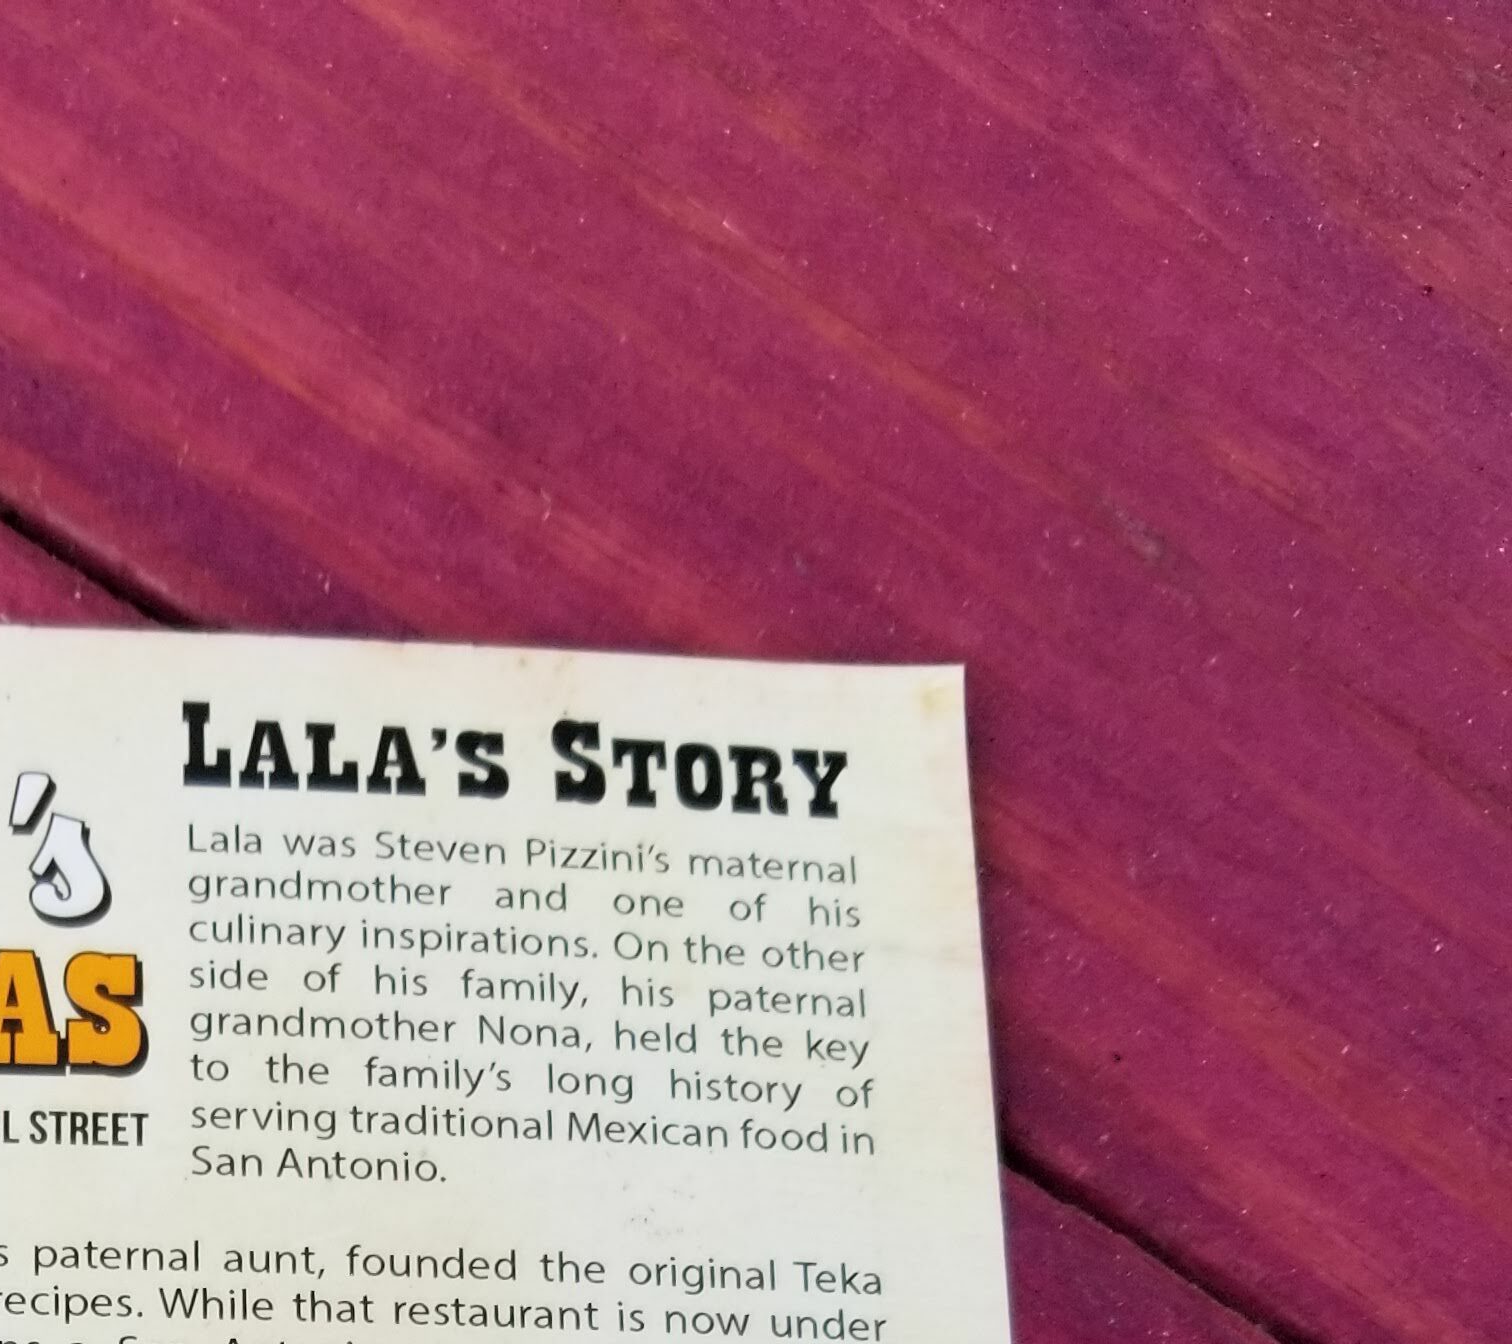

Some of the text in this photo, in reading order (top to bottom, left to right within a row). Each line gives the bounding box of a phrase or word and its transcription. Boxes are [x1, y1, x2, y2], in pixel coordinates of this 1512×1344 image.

[184, 703, 847, 818] LALA'S STORY
[189, 823, 856, 884] Lala was Steven Pizzini's maternal
[189, 913, 864, 972] culinary inspirations. On the other
[190, 1006, 869, 1070] grandmother Nona, held the key
[30, 1111, 150, 1147] STREET
[192, 1101, 874, 1155] serving traditional Mexican food in
[192, 1145, 446, 1182] San Antonio.
[34, 1240, 199, 1276] paternal
[224, 1246, 324, 1279] aunt,
[346, 1244, 516, 1281] founded
[540, 1251, 605, 1284] the
[629, 1257, 775, 1295] original
[793, 1261, 881, 1295] Teka
